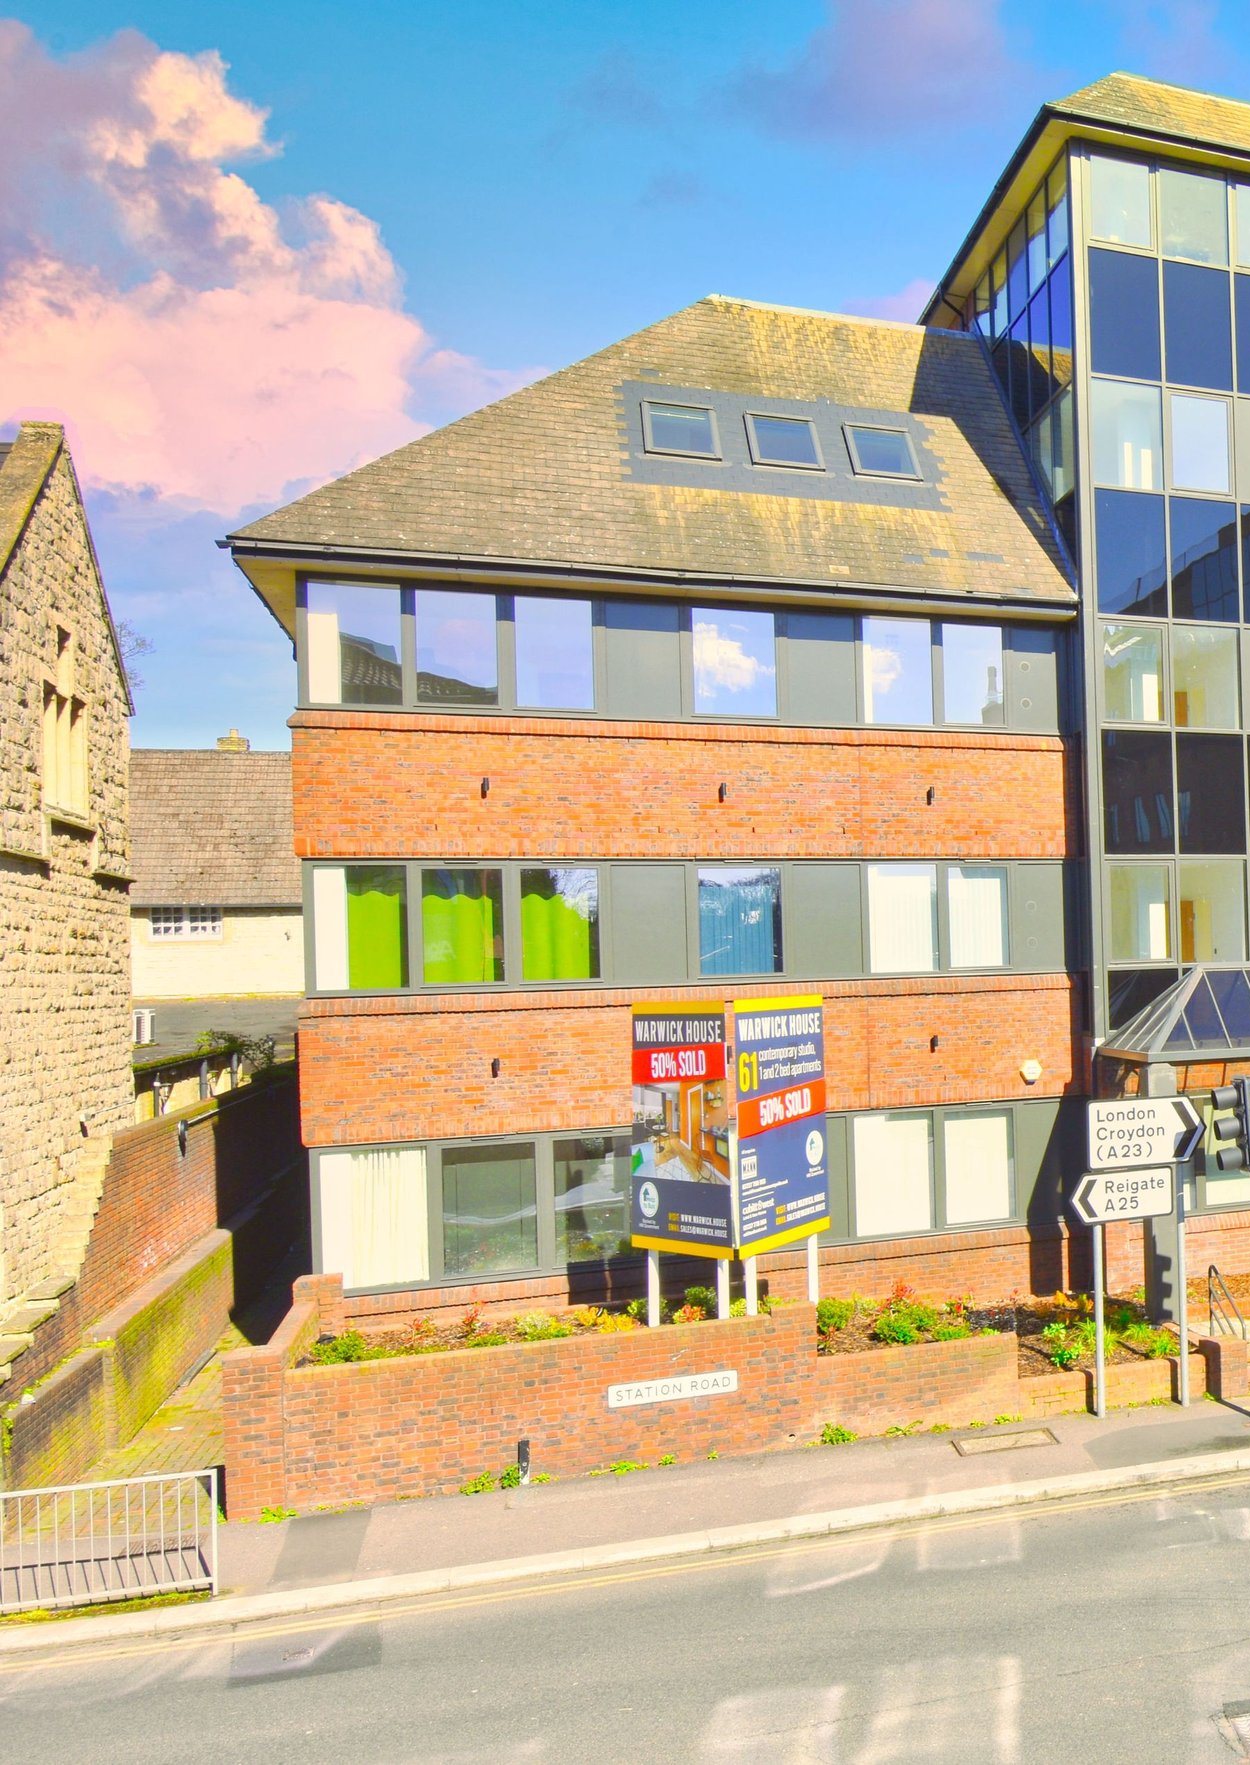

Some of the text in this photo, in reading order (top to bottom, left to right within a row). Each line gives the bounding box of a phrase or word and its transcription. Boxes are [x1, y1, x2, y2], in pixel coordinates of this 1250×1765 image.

[635, 1020, 722, 1042] WARWICK HOUSE
[738, 1012, 820, 1041] WARWICK HOUSE
[758, 1045, 798, 1061] contemporary
[650, 1050, 706, 1078] 50% SOLD
[739, 1051, 758, 1092] 61
[763, 1064, 775, 1079] and
[780, 1062, 791, 1076] bed
[791, 1059, 821, 1077] apartments
[760, 1088, 811, 1126] 50% SOLD
[1096, 1107, 1156, 1122] London
[1096, 1124, 1165, 1141] Croydon
[1096, 1141, 1152, 1161] (A23)
[1105, 1177, 1165, 1194] Reigate
[1104, 1196, 1139, 1212] A25
[615, 1376, 731, 1402] STATION ROAD
